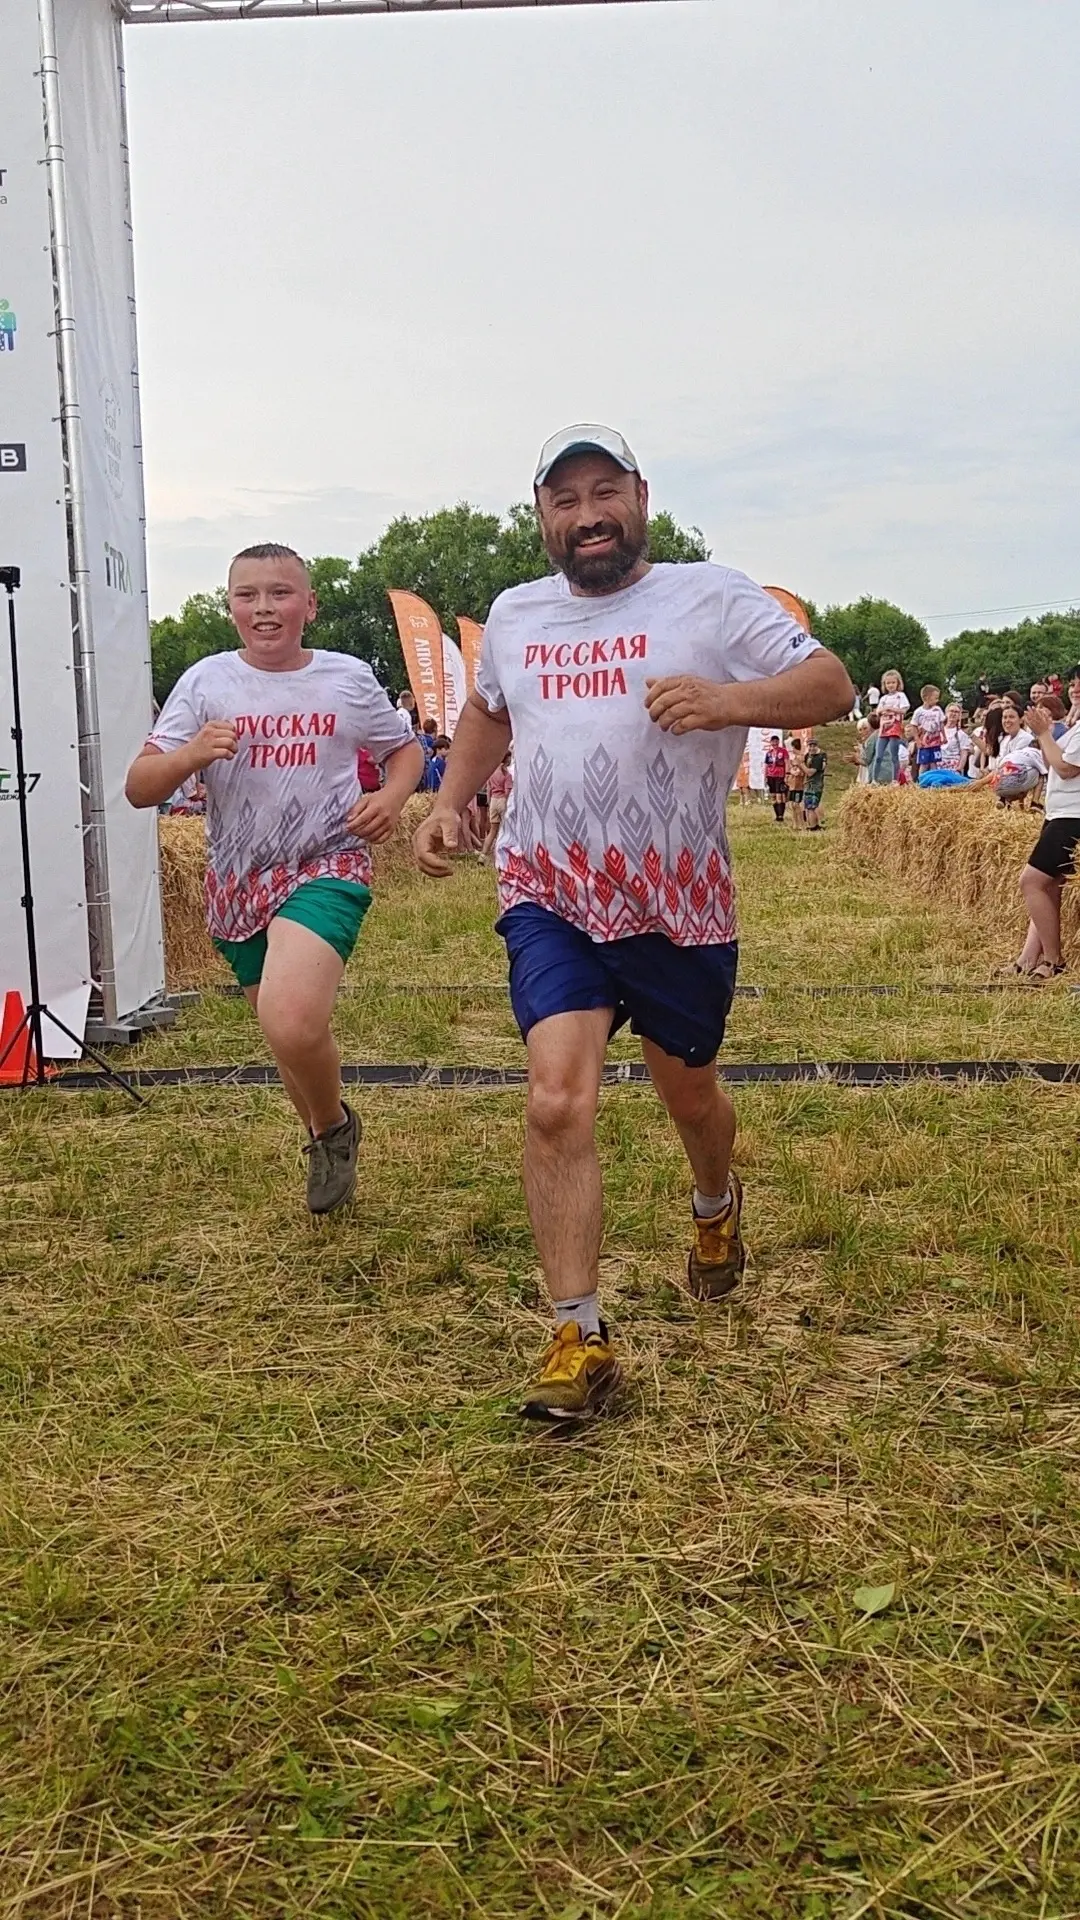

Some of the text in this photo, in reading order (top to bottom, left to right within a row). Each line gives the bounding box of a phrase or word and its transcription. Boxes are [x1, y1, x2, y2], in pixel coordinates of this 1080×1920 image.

[524, 634, 647, 669] РУССКАЯ
[537, 667, 627, 700] ТРОПА
[235, 713, 336, 740] РУССКАЯ
[249, 742, 316, 768] ТРОПА
